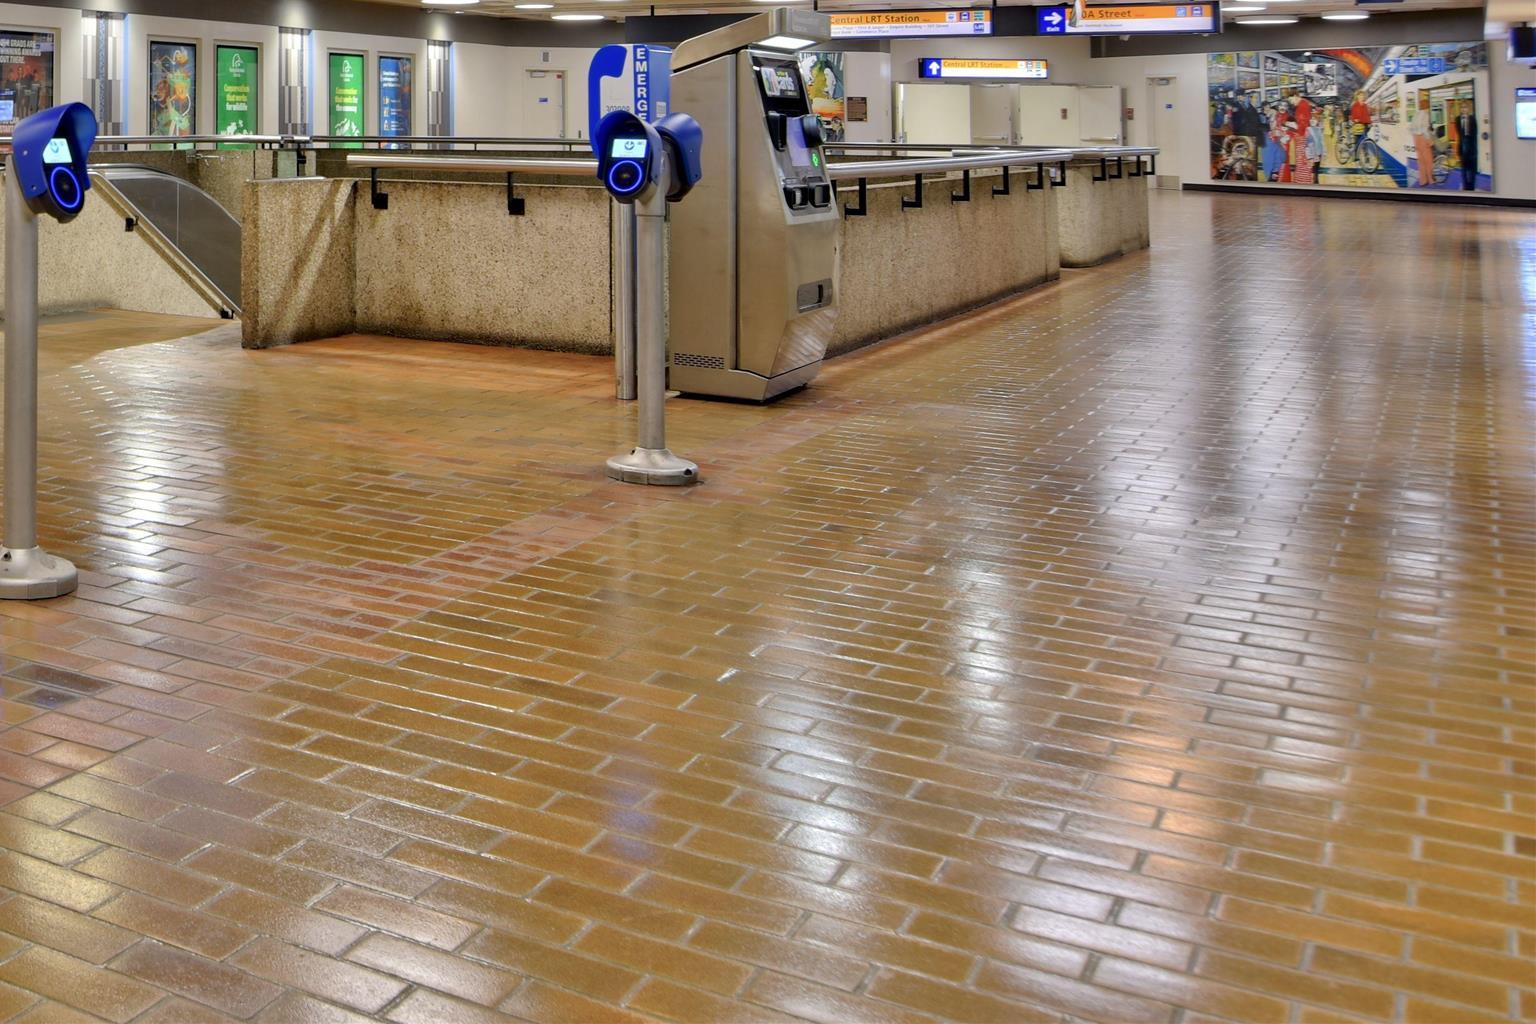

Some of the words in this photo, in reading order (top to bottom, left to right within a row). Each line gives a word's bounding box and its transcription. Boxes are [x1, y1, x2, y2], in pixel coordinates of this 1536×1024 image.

[865, 15, 881, 23] LRT
[884, 14, 920, 23] Station
[1098, 10, 1132, 18] Street
[635, 48, 648, 120] EMERGE
